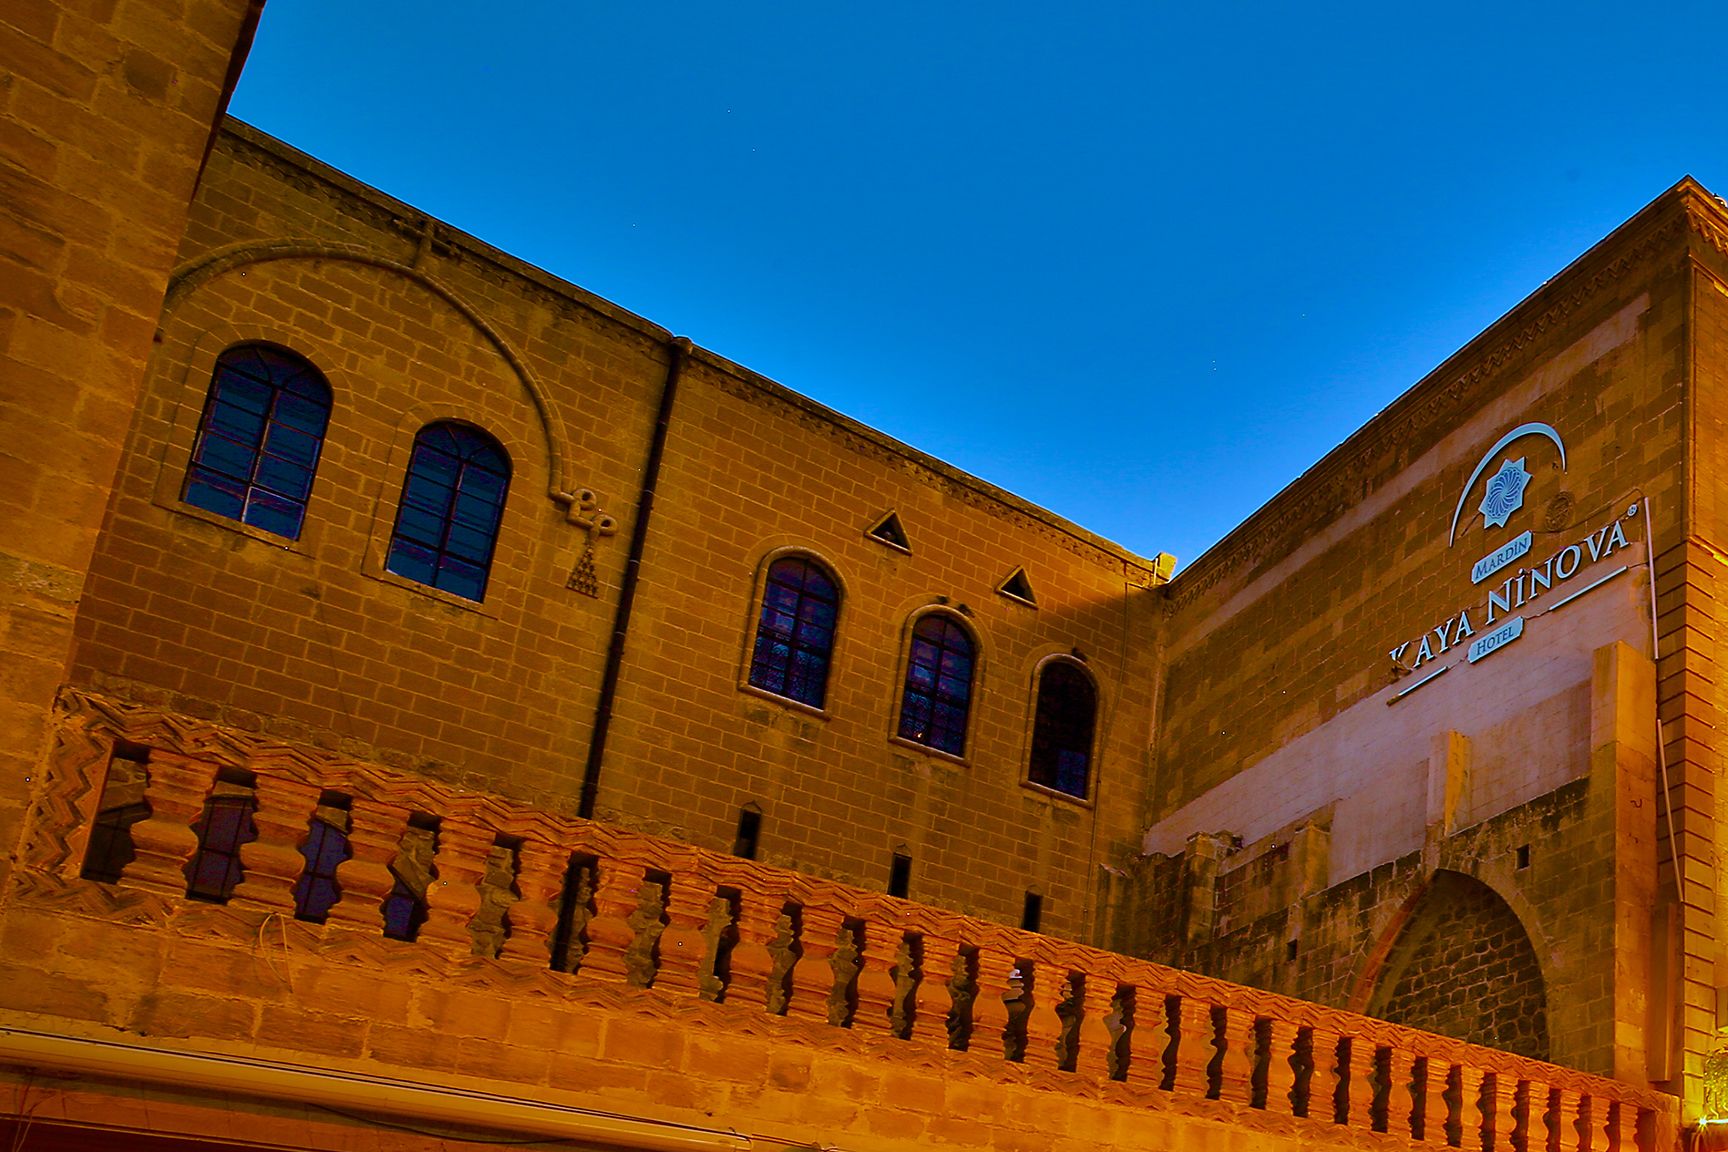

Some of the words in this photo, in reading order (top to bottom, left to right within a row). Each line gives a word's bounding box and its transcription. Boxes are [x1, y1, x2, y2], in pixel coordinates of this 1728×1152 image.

[1475, 538, 1528, 579] MARDİN
[1388, 611, 1476, 674] KAYA
[1485, 520, 1630, 626] NİNOVA
[1476, 626, 1514, 656] HOTEL
